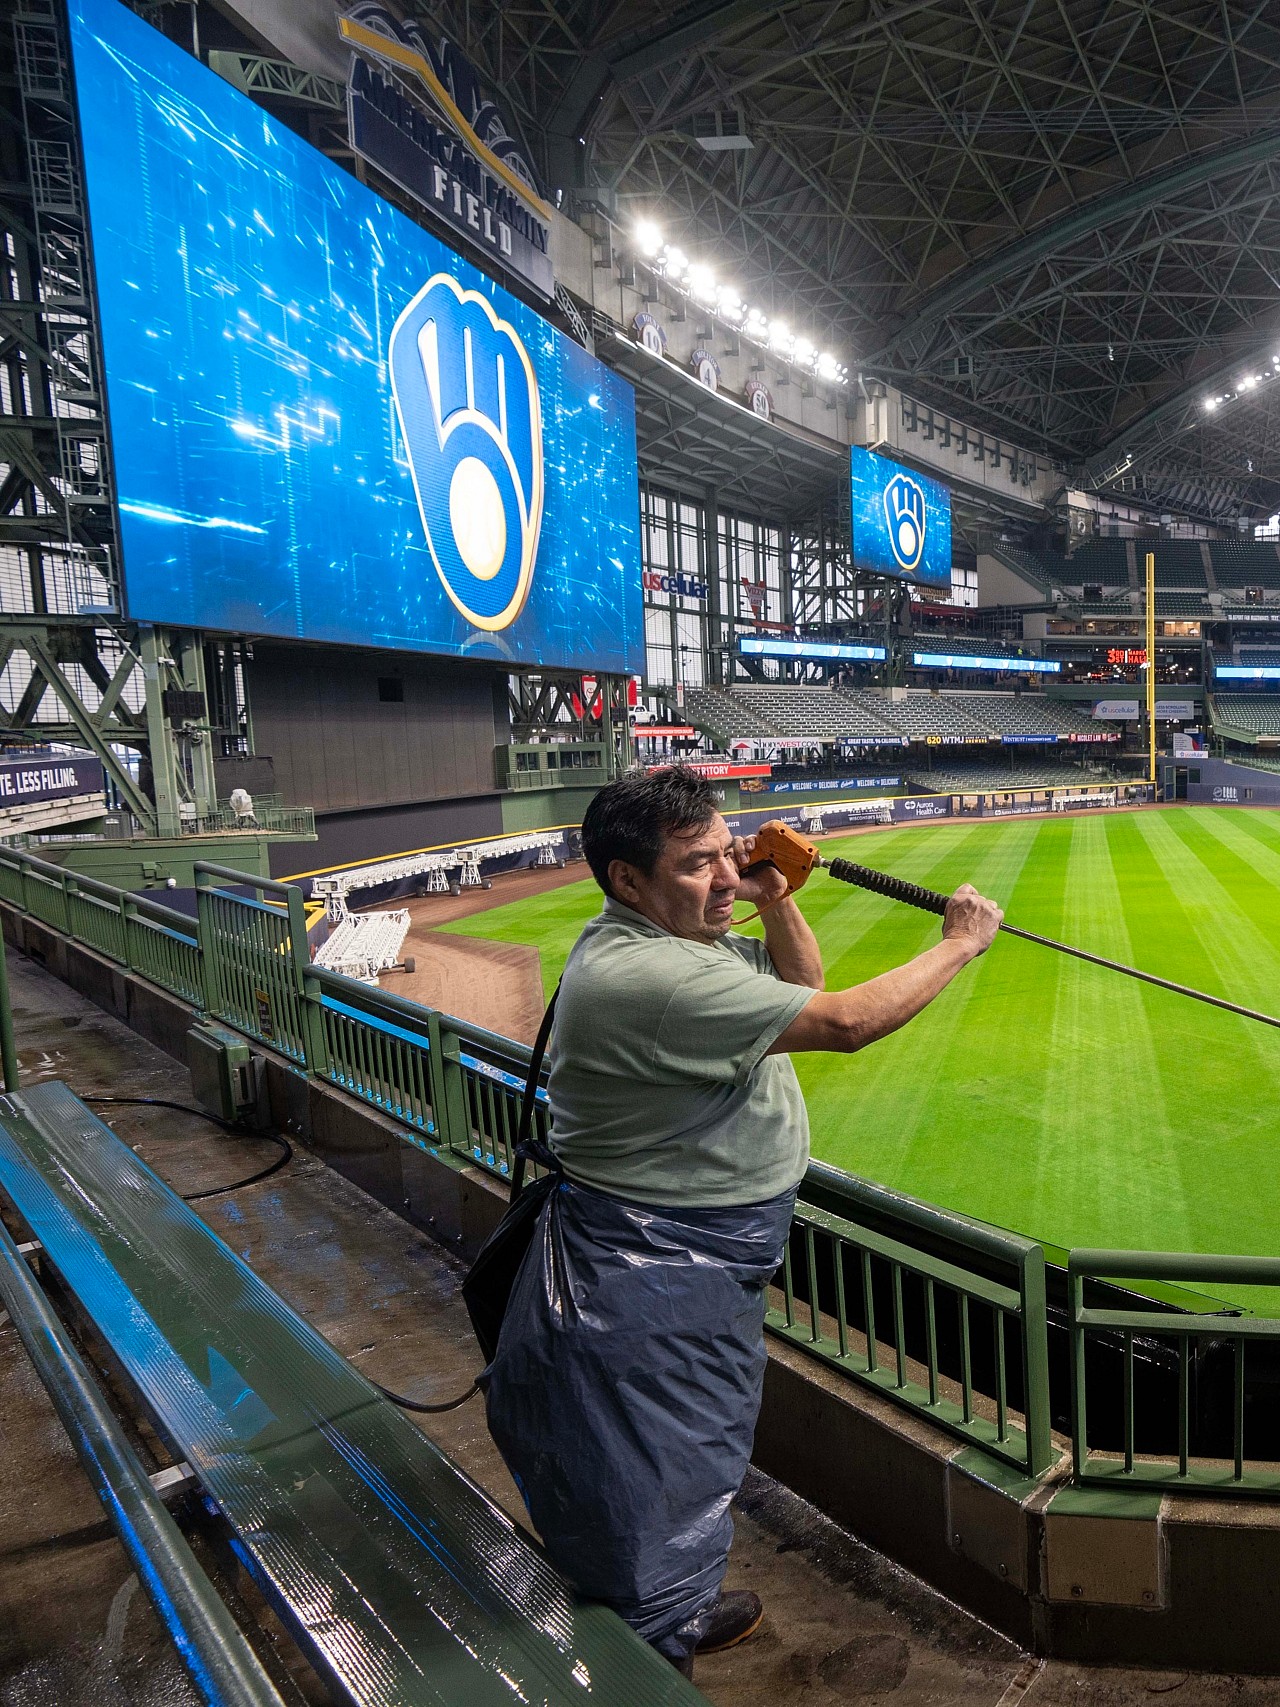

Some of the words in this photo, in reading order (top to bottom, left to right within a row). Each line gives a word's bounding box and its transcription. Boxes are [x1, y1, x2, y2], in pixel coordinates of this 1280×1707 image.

[433, 165, 512, 256] FIELD
[645, 331, 660, 353] 19
[704, 367, 711, 386] 4
[756, 393, 767, 410] 50
[1108, 706, 1136, 714] uscellular
[926, 736, 942, 745] 620
[942, 736, 964, 744] WTMJ
[1077, 734, 1093, 742] NICOLET
[16, 771, 40, 794] LESS
[41, 767, 79, 790] FILLING.
[792, 782, 812, 790] WELCOME
[856, 779, 875, 787] WELCOME
[916, 807, 933, 816] Health
[934, 806, 947, 815] Care
